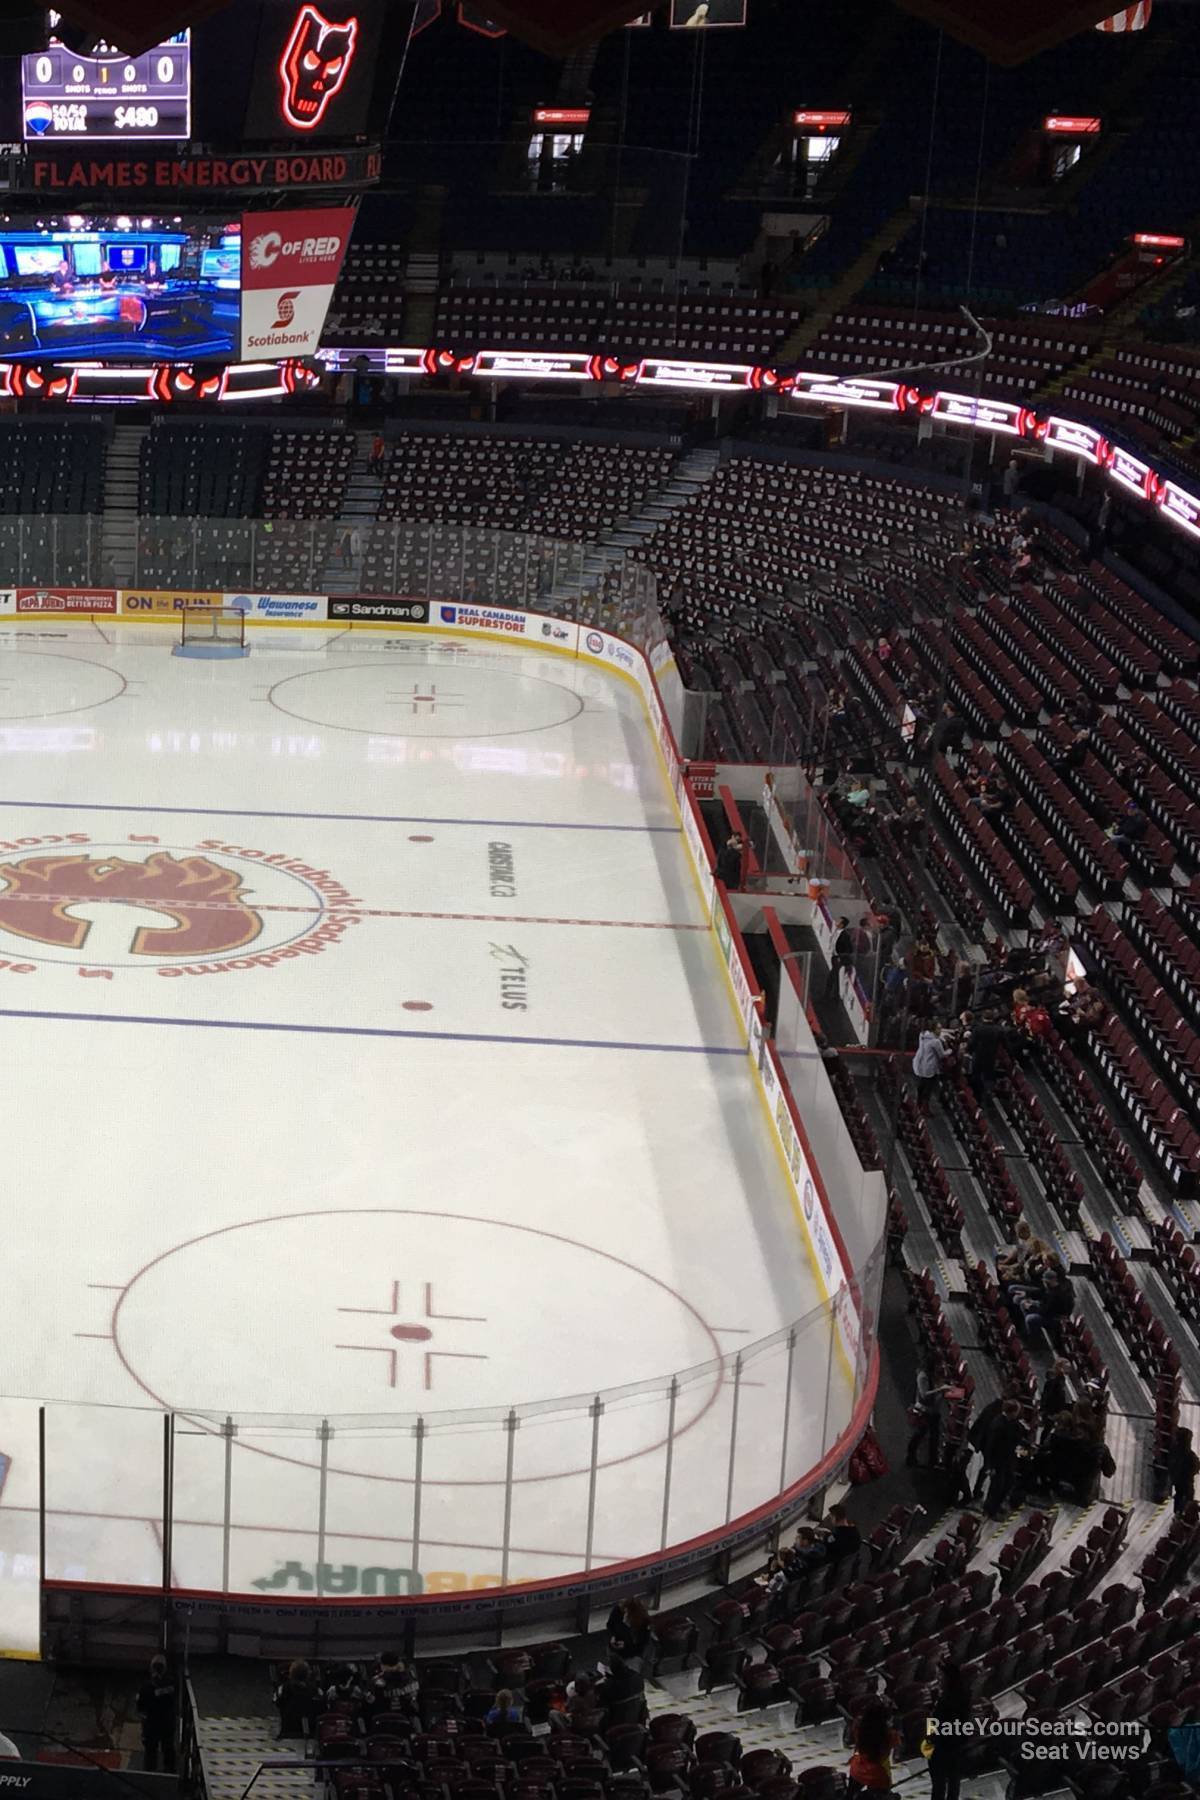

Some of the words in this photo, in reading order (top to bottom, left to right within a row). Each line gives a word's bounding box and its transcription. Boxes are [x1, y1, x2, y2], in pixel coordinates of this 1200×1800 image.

[36, 57, 52, 82] 0
[73, 65, 85, 82] 0
[102, 67, 108, 83] 1
[124, 65, 136, 82] 0
[157, 57, 174, 83] 0
[53, 117, 87, 131] TOTAL
[114, 106, 158, 128] $480
[34, 161, 148, 187] FLAMES
[155, 158, 268, 186] ENERGY
[275, 156, 347, 183] BOARD
[301, 236, 341, 257] RED
[247, 332, 310, 348] Scotiabank
[126, 597, 152, 609] ON
[257, 597, 318, 610] Wawanesa
[351, 603, 410, 617] Sandman
[458, 608, 481, 617] REAL
[482, 610, 526, 623] CANADIAN
[457, 616, 526, 633] SUPERSTORE
[195, 837, 367, 910] Scotiabank
[158, 912, 363, 979] Saddledome
[500, 967, 528, 1011] TELUS
